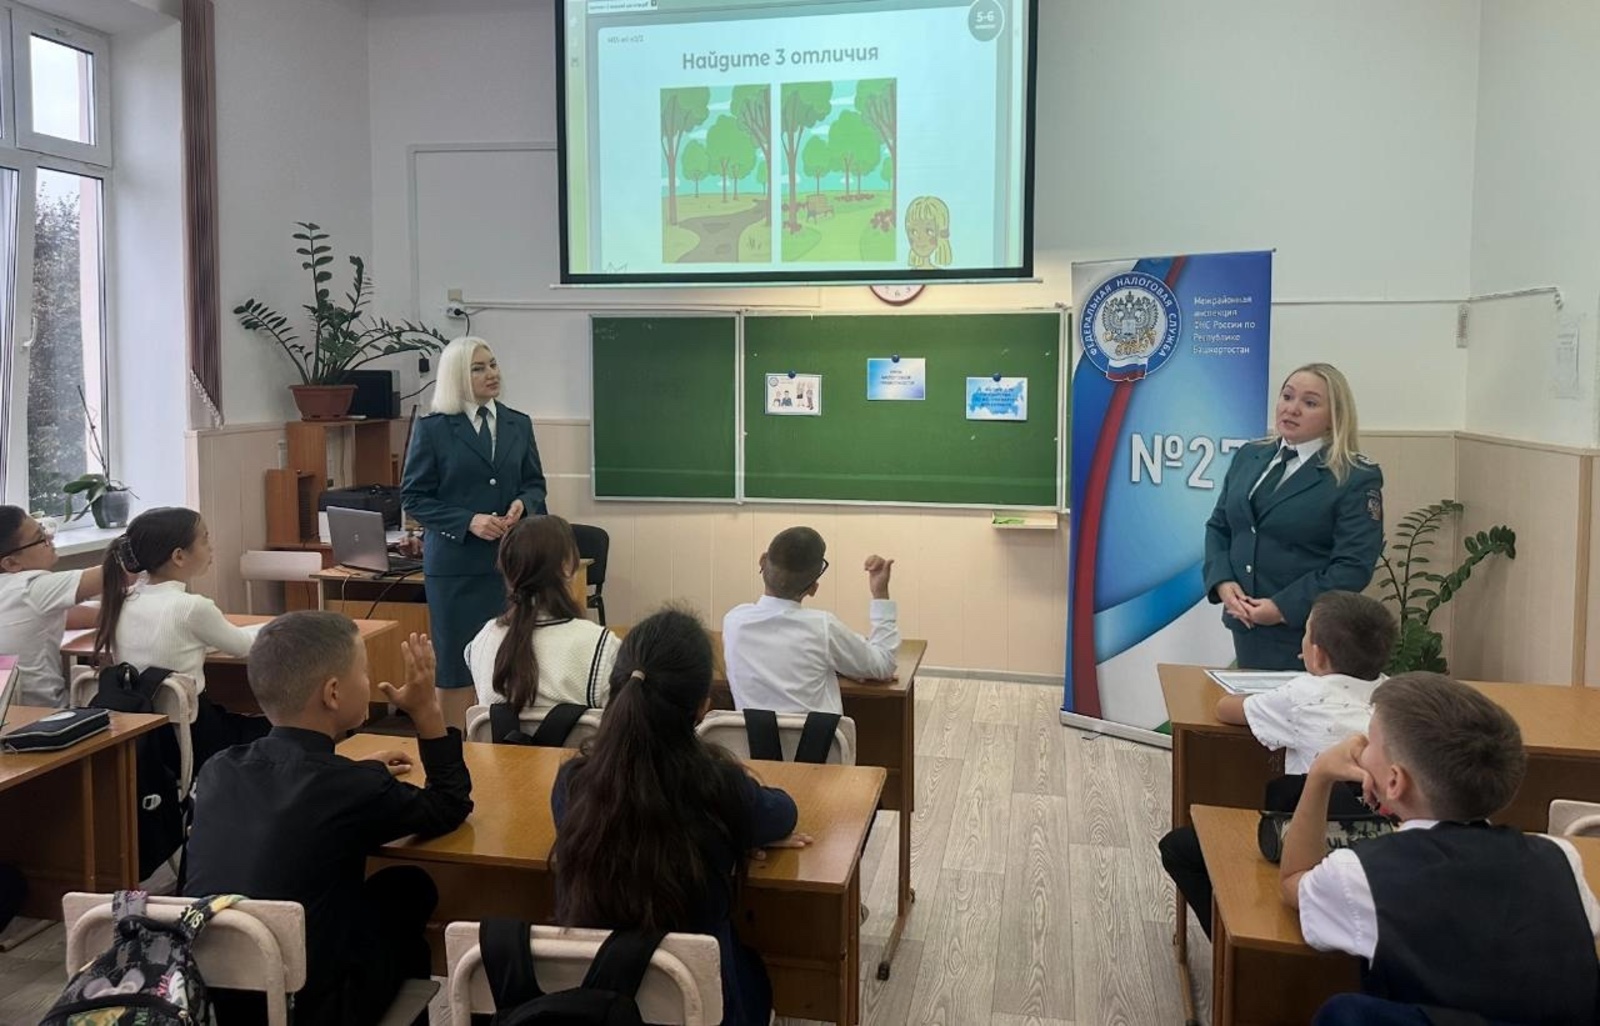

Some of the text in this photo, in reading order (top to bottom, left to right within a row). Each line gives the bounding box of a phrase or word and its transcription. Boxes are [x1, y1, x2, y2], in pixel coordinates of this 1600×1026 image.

[976, 10, 995, 23] 5-6
[682, 46, 879, 72] Найдите 3 отличия
[1083, 277, 1178, 357] ФЕДЕРАЛЬНАЯ НАЛОГОВАЯ СЛУЖБА
[1213, 320, 1243, 329] России
[1244, 321, 1256, 329] по
[1193, 345, 1250, 355] Башкортостан
